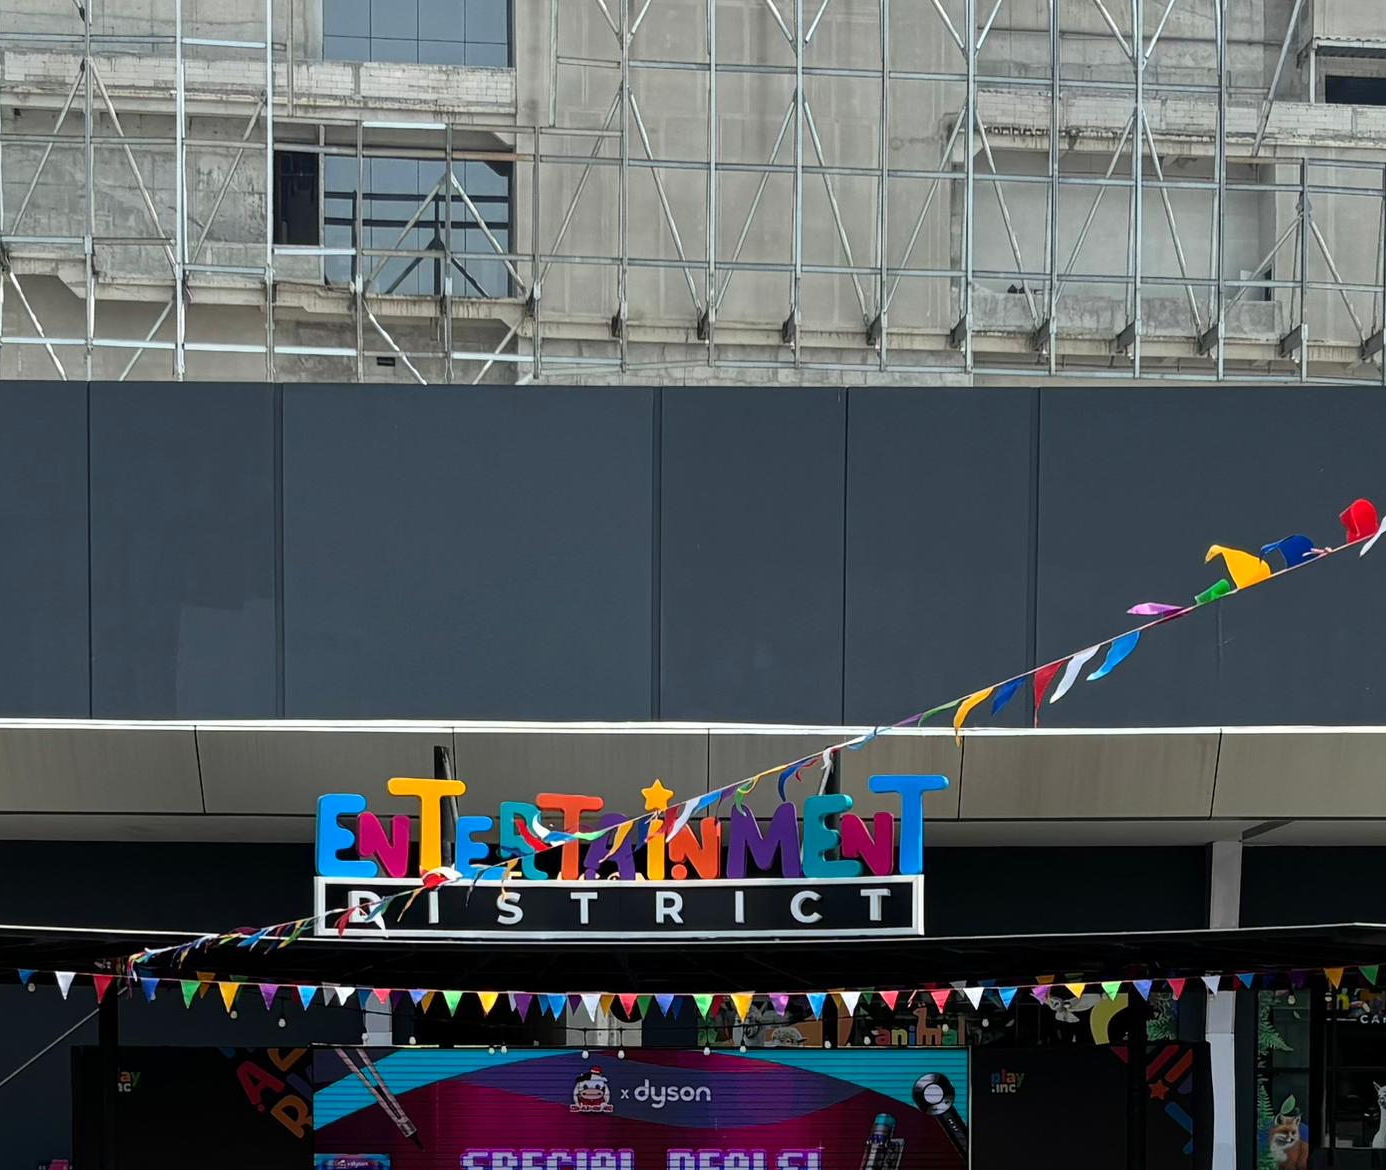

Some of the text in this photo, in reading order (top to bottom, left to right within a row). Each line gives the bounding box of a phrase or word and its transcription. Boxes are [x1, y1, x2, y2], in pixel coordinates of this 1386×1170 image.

[348, 888, 891, 925] DISTRICT
[991, 1069, 1025, 1087] play
[634, 1079, 712, 1108] dyson
